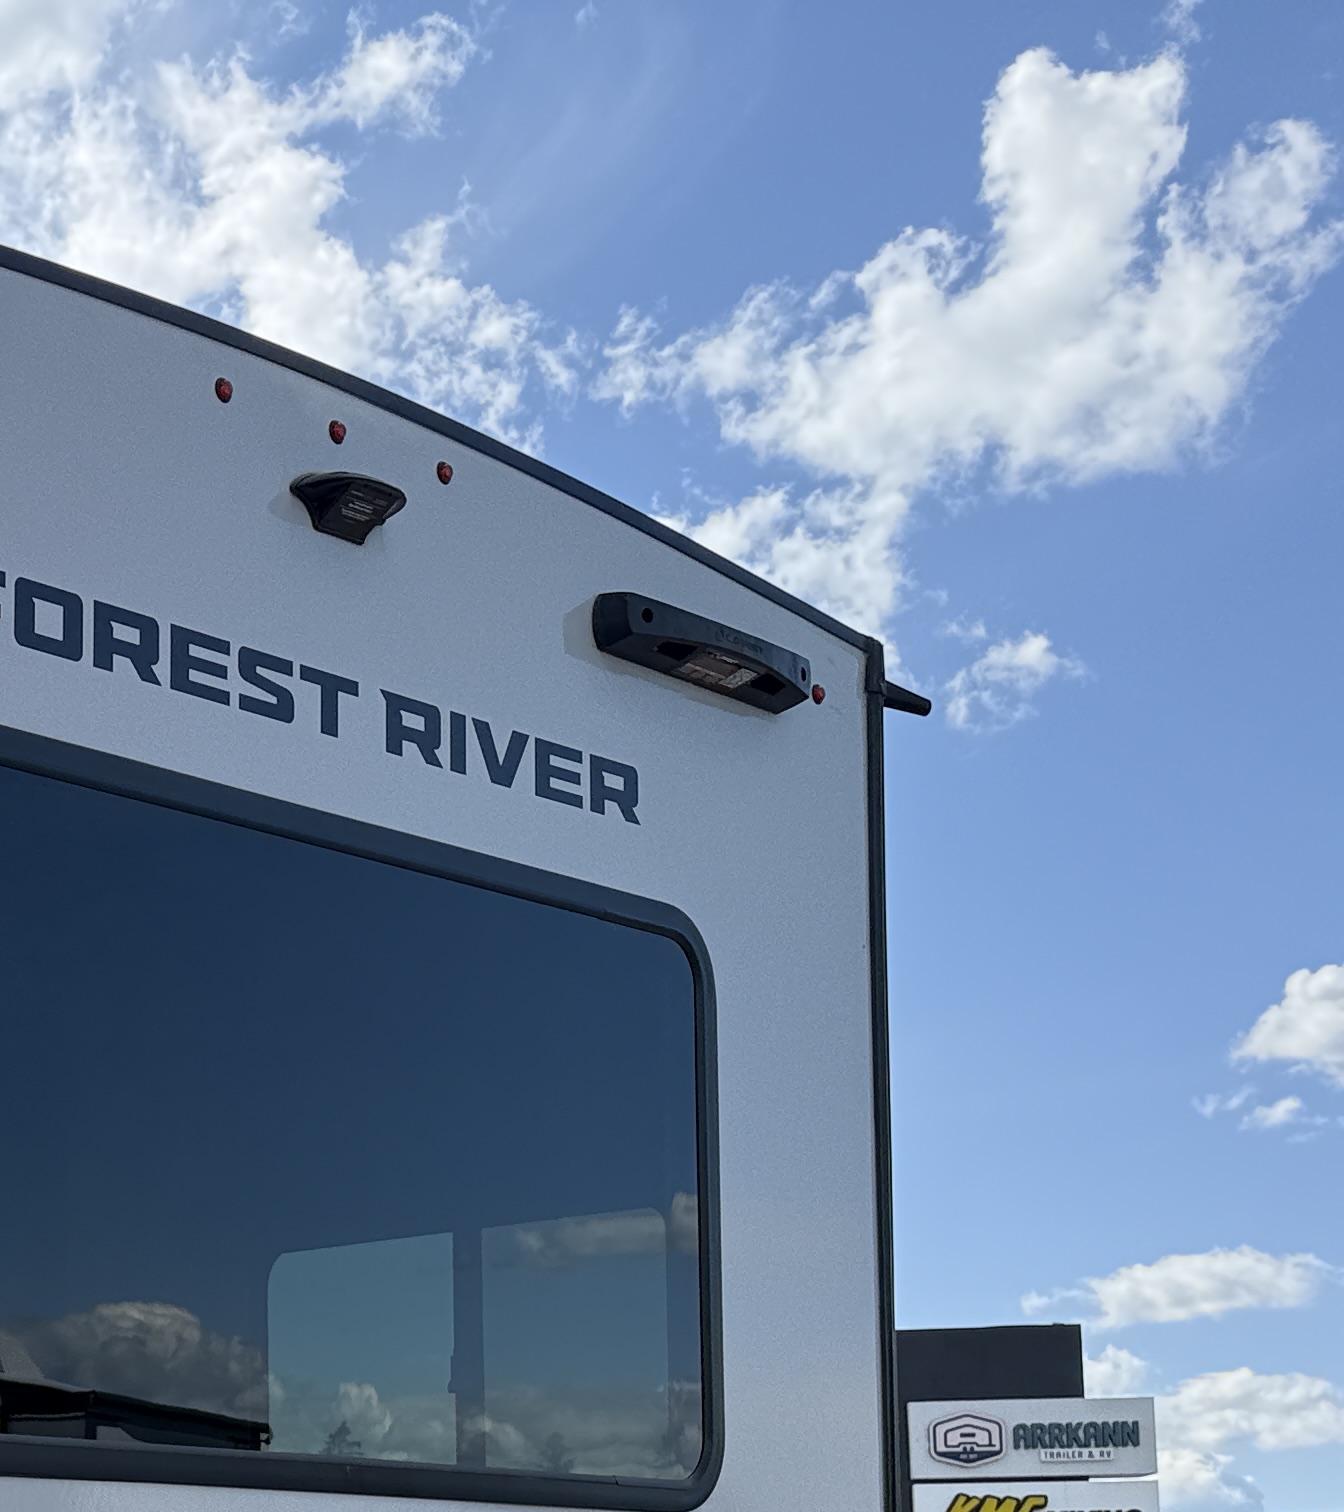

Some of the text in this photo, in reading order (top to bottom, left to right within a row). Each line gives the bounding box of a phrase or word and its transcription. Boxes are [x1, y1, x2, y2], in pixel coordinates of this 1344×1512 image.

[379, 688, 641, 826] RIVER
[1012, 1420, 1141, 1450] ARRKANN
[1044, 1451, 1084, 1460] TRAILER
[1099, 1450, 1112, 1459] RV
